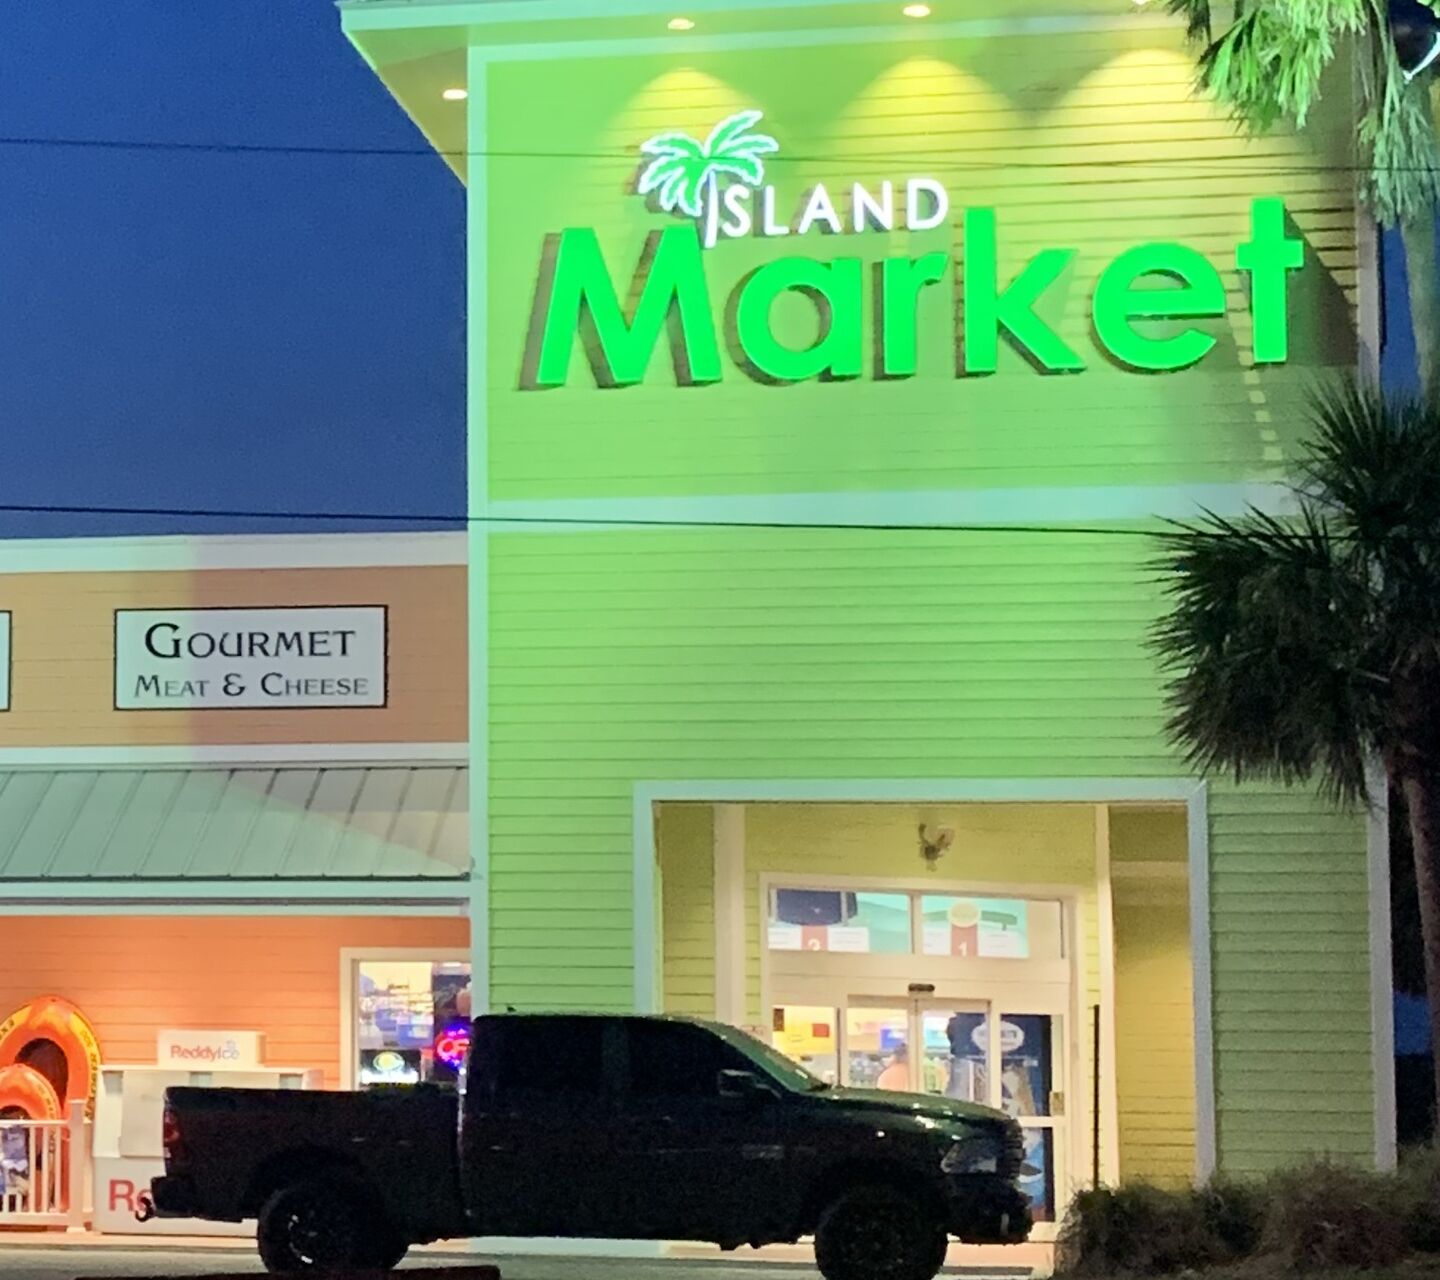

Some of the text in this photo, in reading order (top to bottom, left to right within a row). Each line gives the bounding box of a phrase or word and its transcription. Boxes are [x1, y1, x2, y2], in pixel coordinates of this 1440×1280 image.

[534, 196, 1305, 387] Market
[144, 622, 357, 659] GOURMET
[133, 671, 370, 699] MEAT & CHEESE
